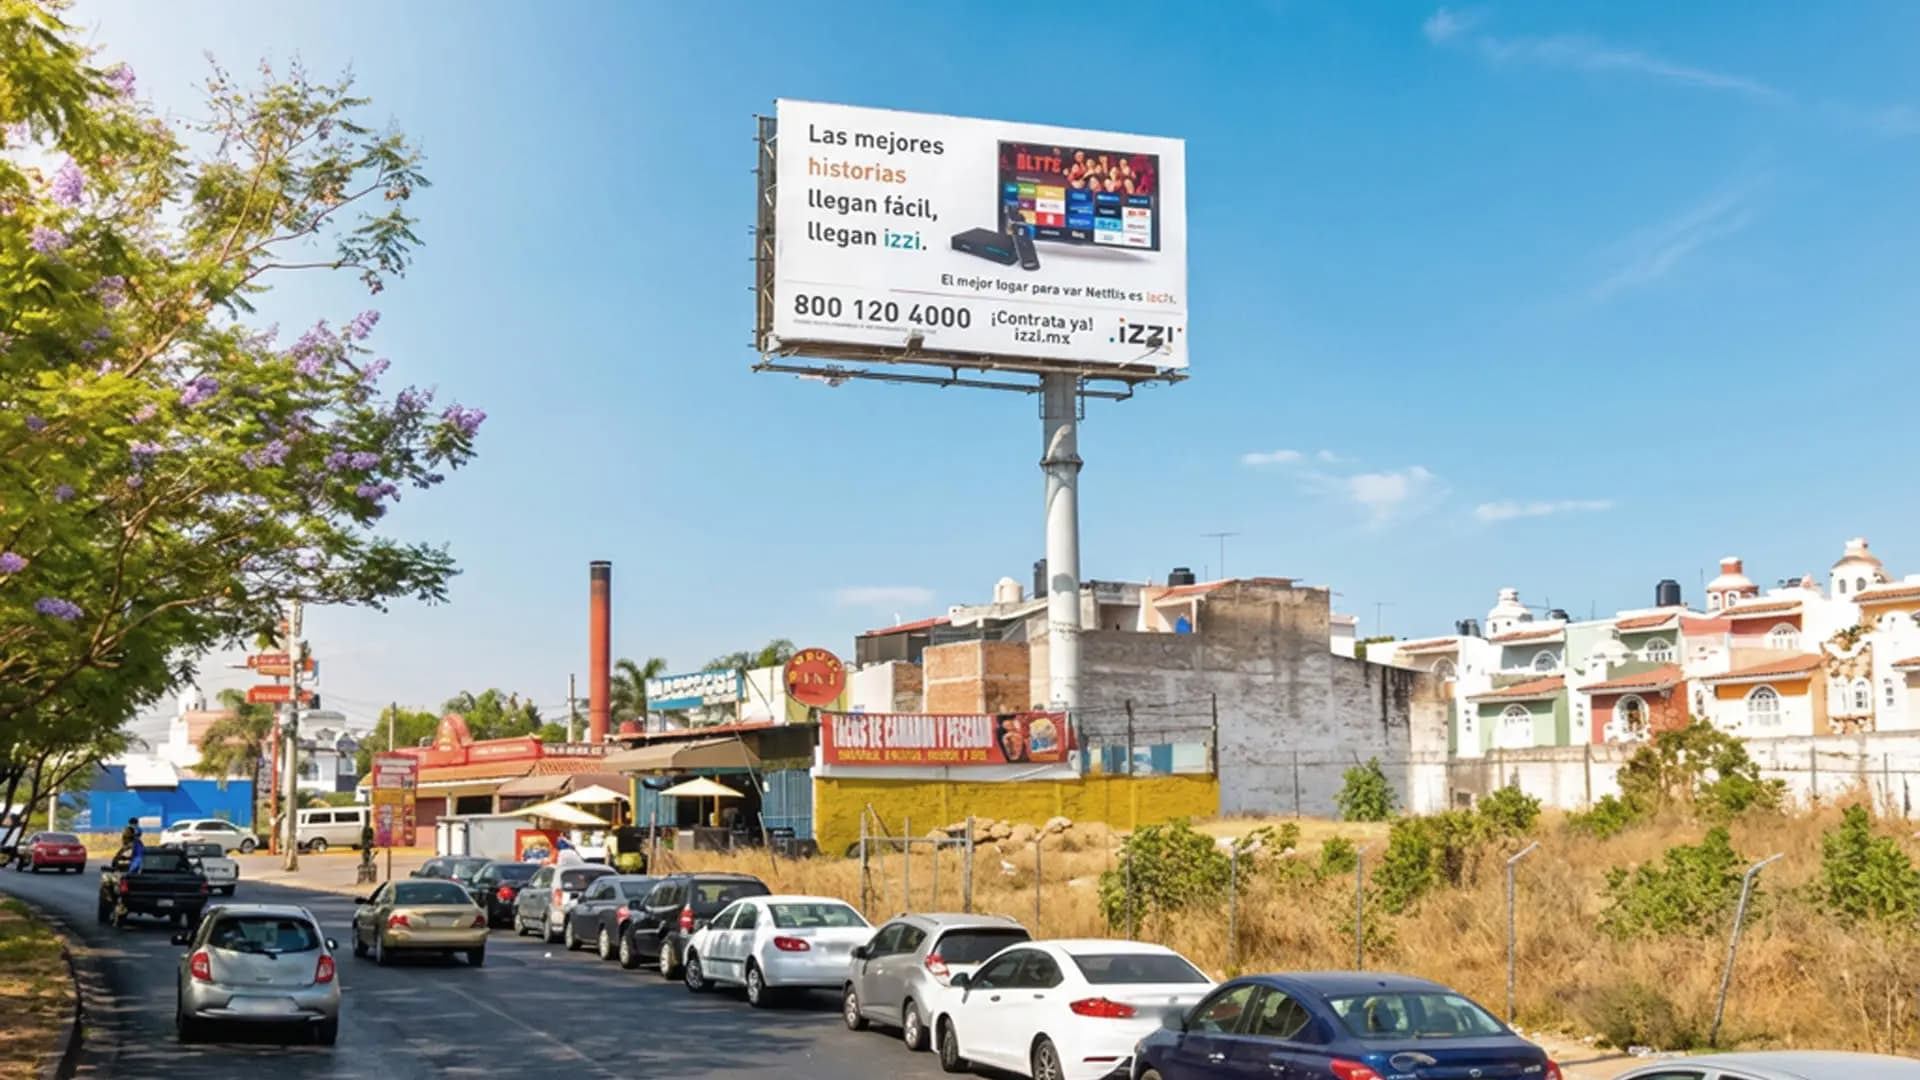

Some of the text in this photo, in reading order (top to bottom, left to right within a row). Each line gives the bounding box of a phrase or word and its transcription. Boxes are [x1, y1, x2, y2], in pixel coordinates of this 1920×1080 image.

[809, 123, 944, 155] Las mejores
[808, 157, 907, 184] historias
[808, 188, 938, 222] llegan fácil,
[807, 221, 927, 251] llegan izzi.
[941, 274, 954, 286] El
[957, 277, 993, 291] mejor
[1032, 284, 1060, 296] para
[1128, 292, 1143, 301] es
[794, 294, 843, 318] 800
[853, 299, 899, 322] 120
[908, 303, 971, 328] 4000
[991, 310, 1094, 333] ¡Contrata ya!
[1014, 327, 1071, 344] izzi.mx
[869, 715, 882, 748] DE
